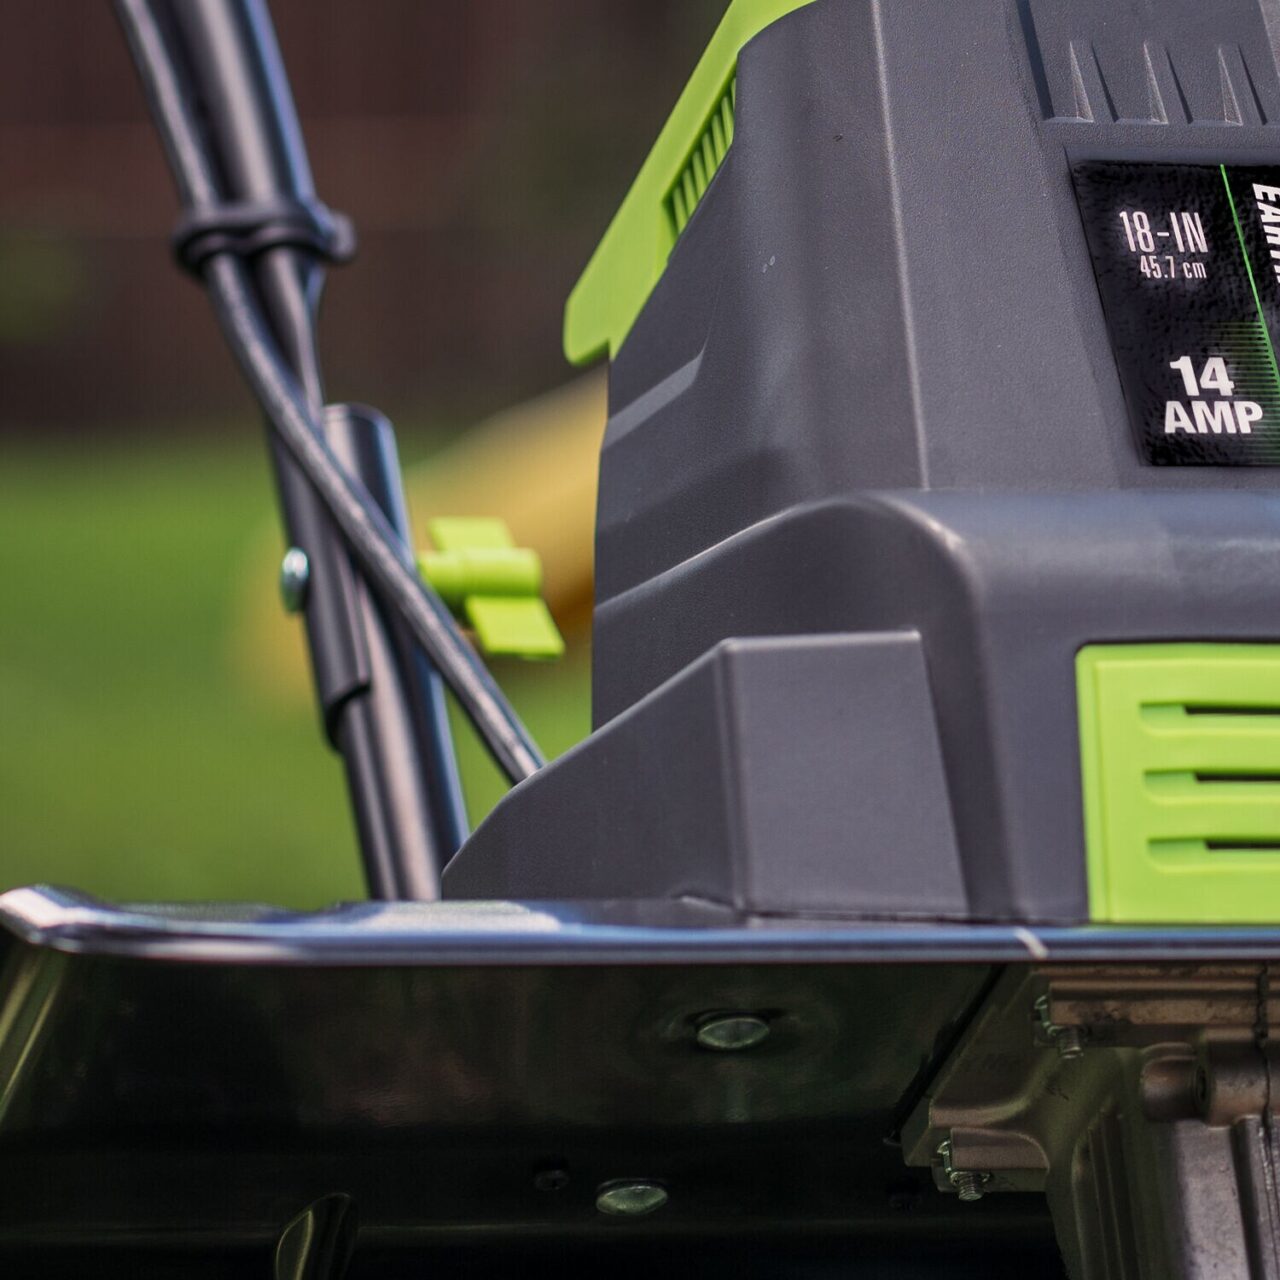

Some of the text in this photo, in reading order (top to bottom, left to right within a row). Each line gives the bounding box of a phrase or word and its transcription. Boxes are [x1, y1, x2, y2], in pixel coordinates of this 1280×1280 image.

[1119, 210, 1209, 253] 18-IN
[1139, 255, 1207, 279] 45.7 cm
[1169, 355, 1235, 397] 14
[1164, 400, 1264, 434] AMP
